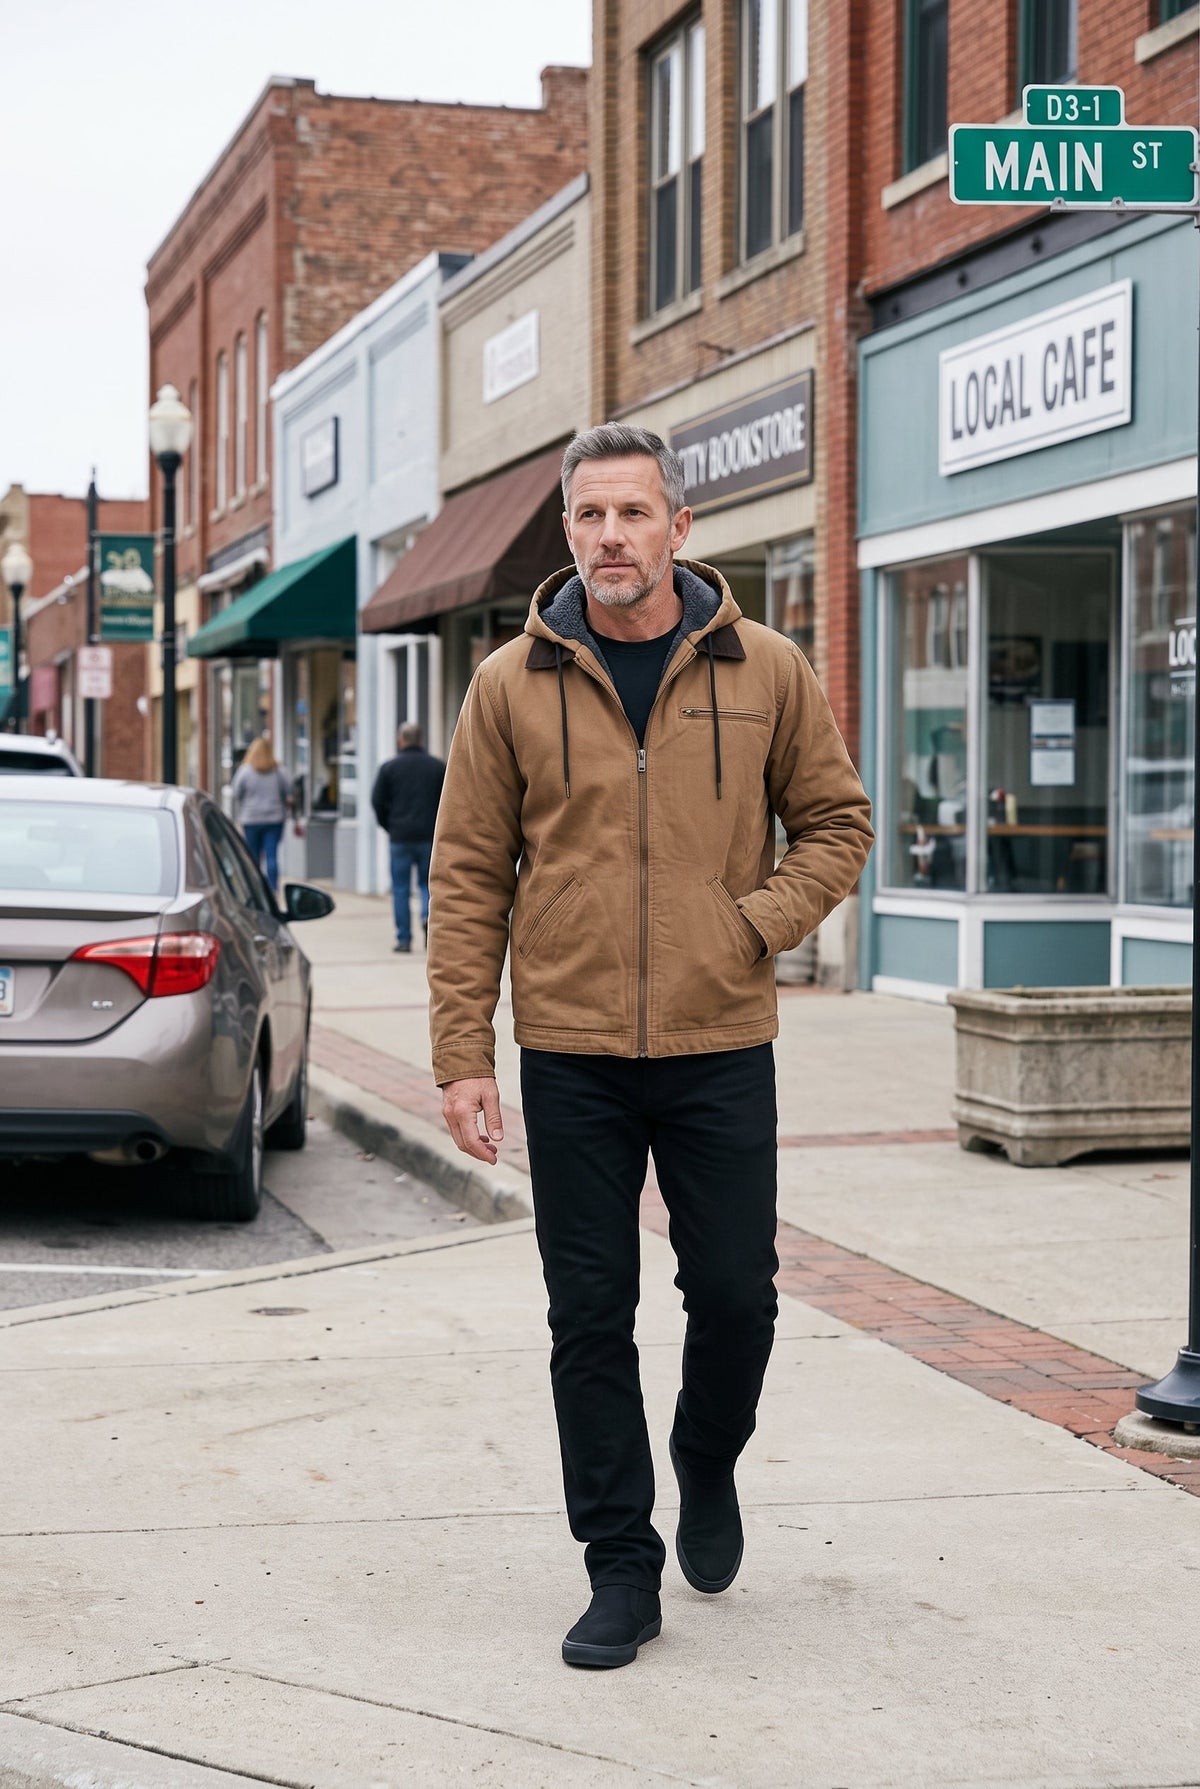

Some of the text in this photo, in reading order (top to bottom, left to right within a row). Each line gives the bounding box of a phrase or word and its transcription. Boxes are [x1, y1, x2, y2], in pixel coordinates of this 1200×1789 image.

[1047, 94, 1100, 121] D3-1
[985, 141, 1162, 191] MAIN ST
[951, 320, 1115, 441] LOCAL CAFE
[679, 403, 805, 490] ITY BOOKSTORE
